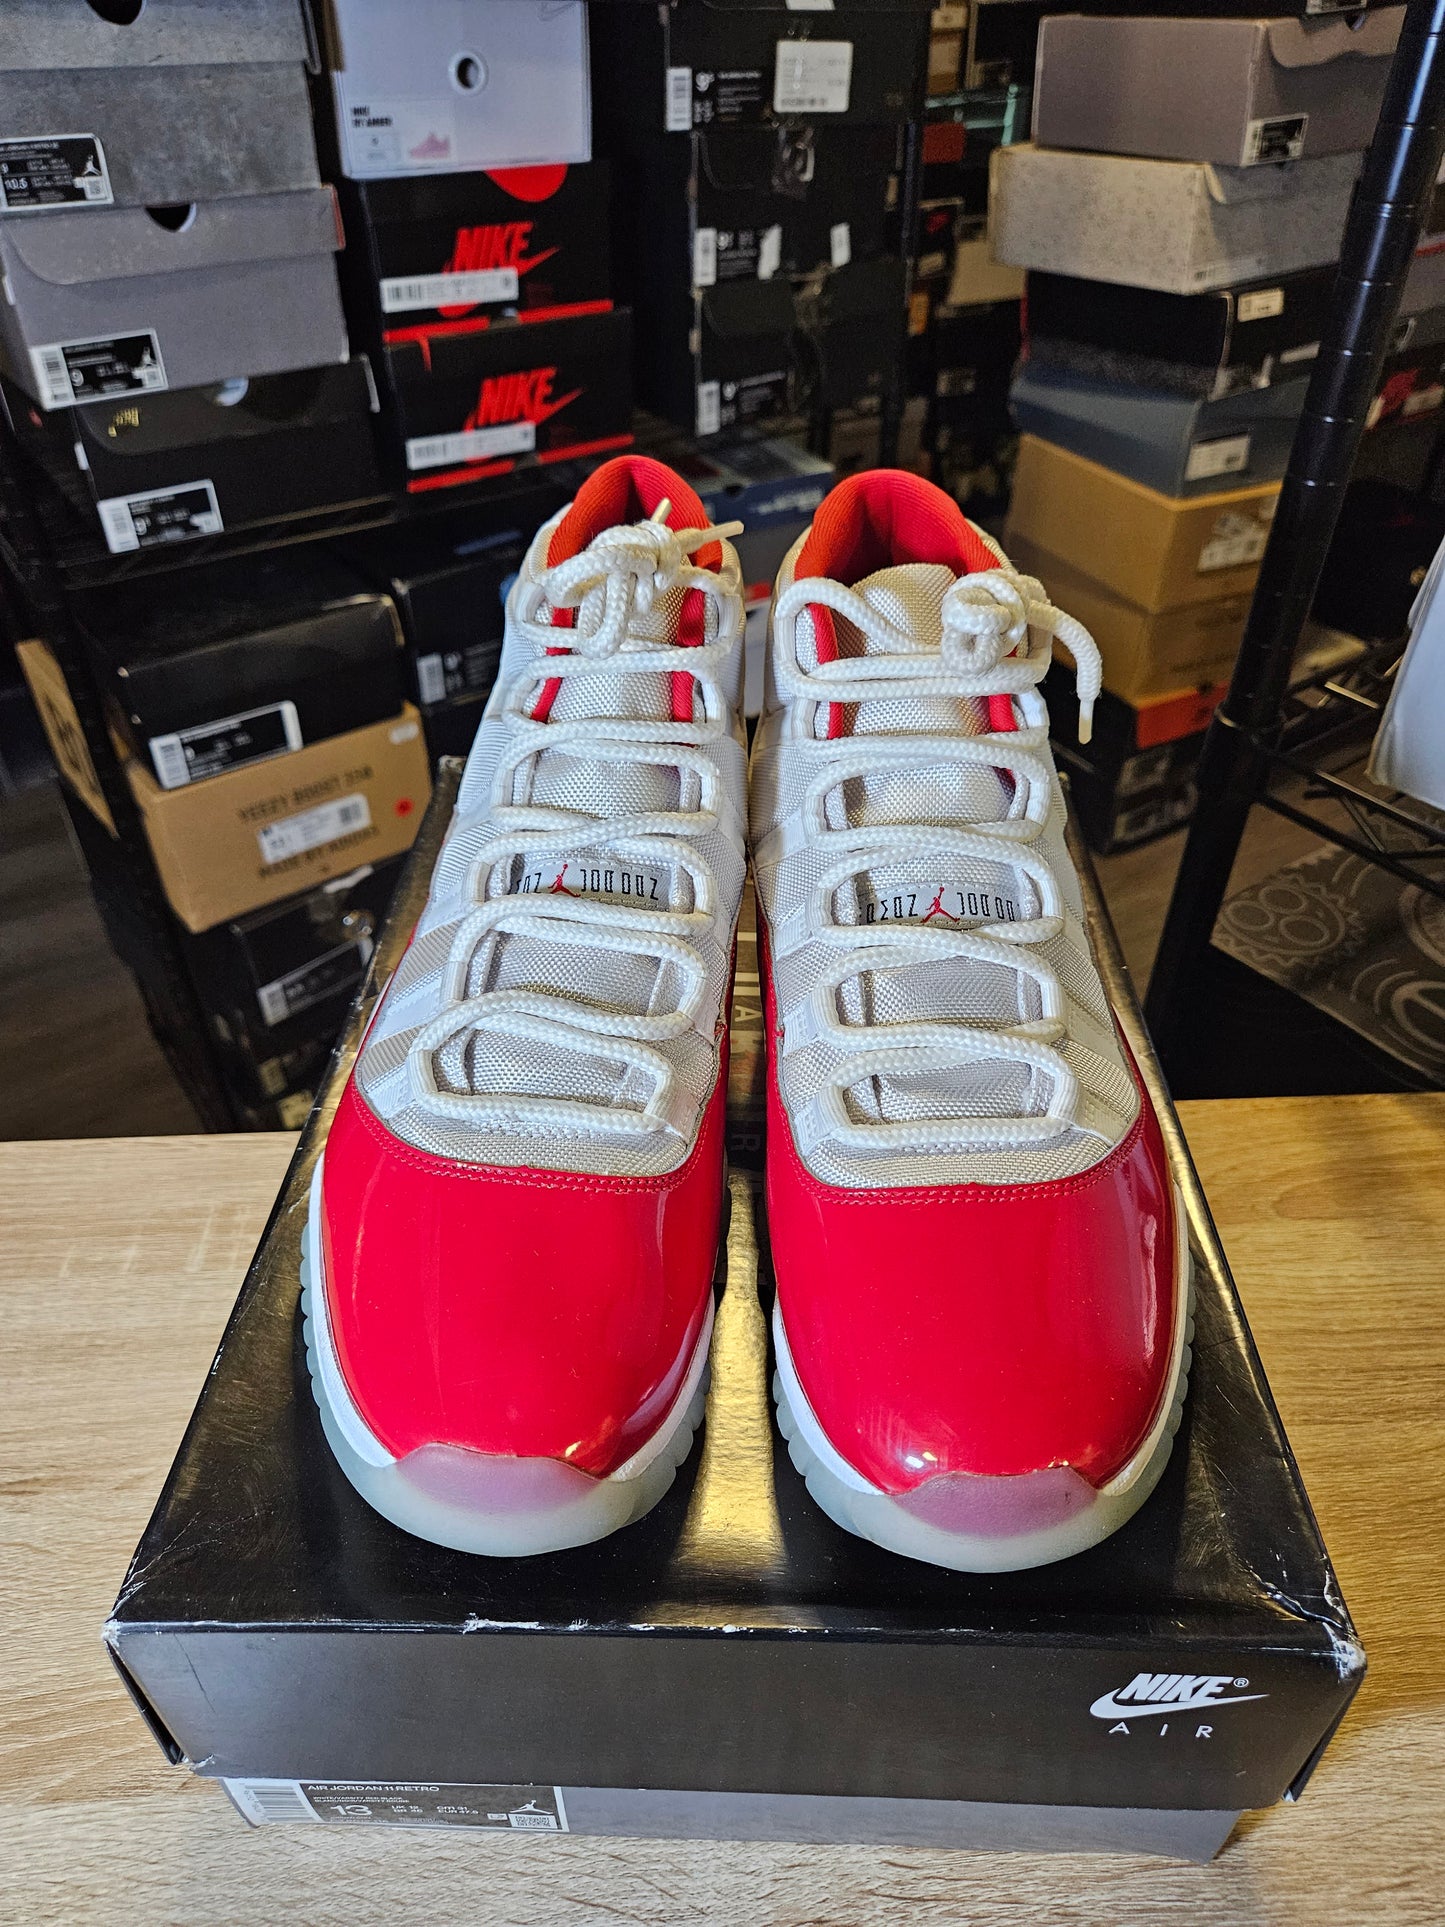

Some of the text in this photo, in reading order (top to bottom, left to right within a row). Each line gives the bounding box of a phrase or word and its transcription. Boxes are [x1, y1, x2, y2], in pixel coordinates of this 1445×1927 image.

[452, 220, 535, 272] NIKE
[477, 365, 558, 426] NIKE
[1116, 1672, 1234, 1702] NIKE
[1108, 1721, 1214, 1738] AIR
[330, 1804, 374, 1816] 13
